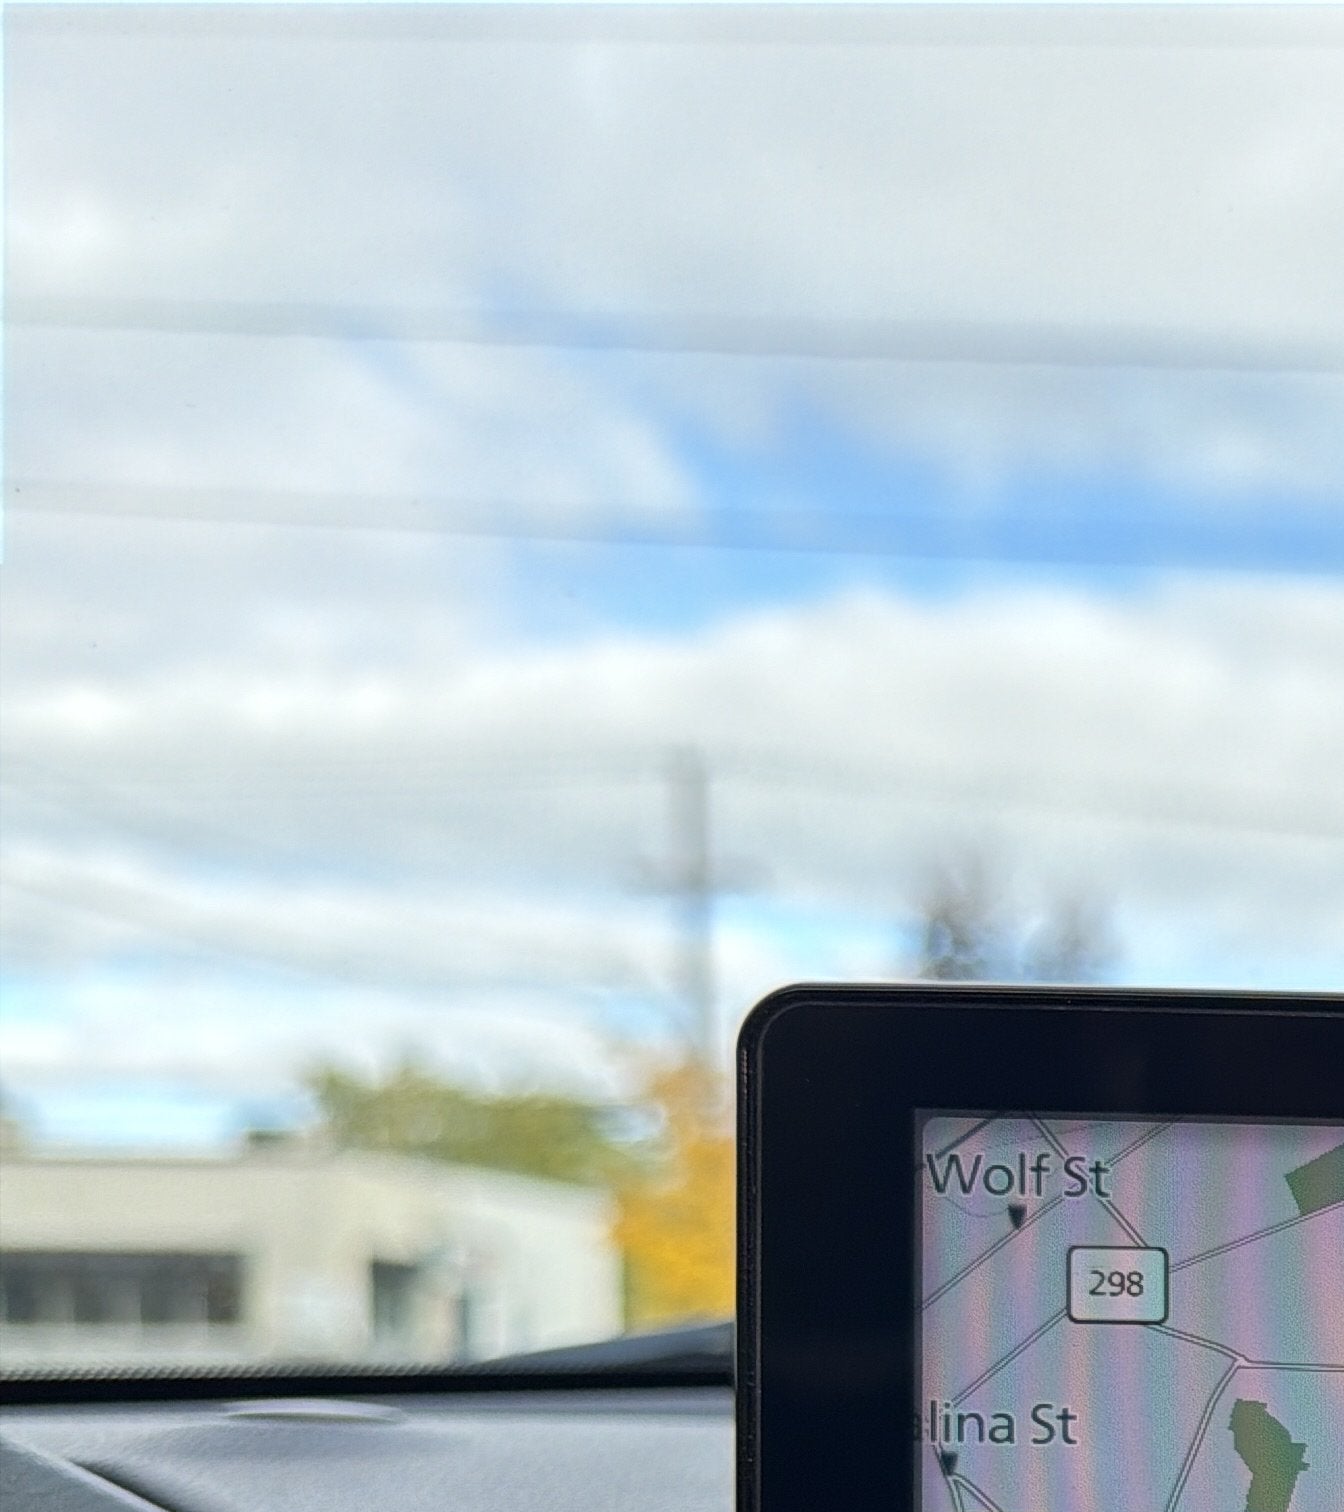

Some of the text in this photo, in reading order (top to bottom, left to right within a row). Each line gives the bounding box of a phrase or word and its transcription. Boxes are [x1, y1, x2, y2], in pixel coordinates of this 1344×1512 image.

[926, 1153, 1110, 1198] Wolf St
[1089, 1270, 1144, 1297] 298
[914, 1400, 1077, 1445] lina St
